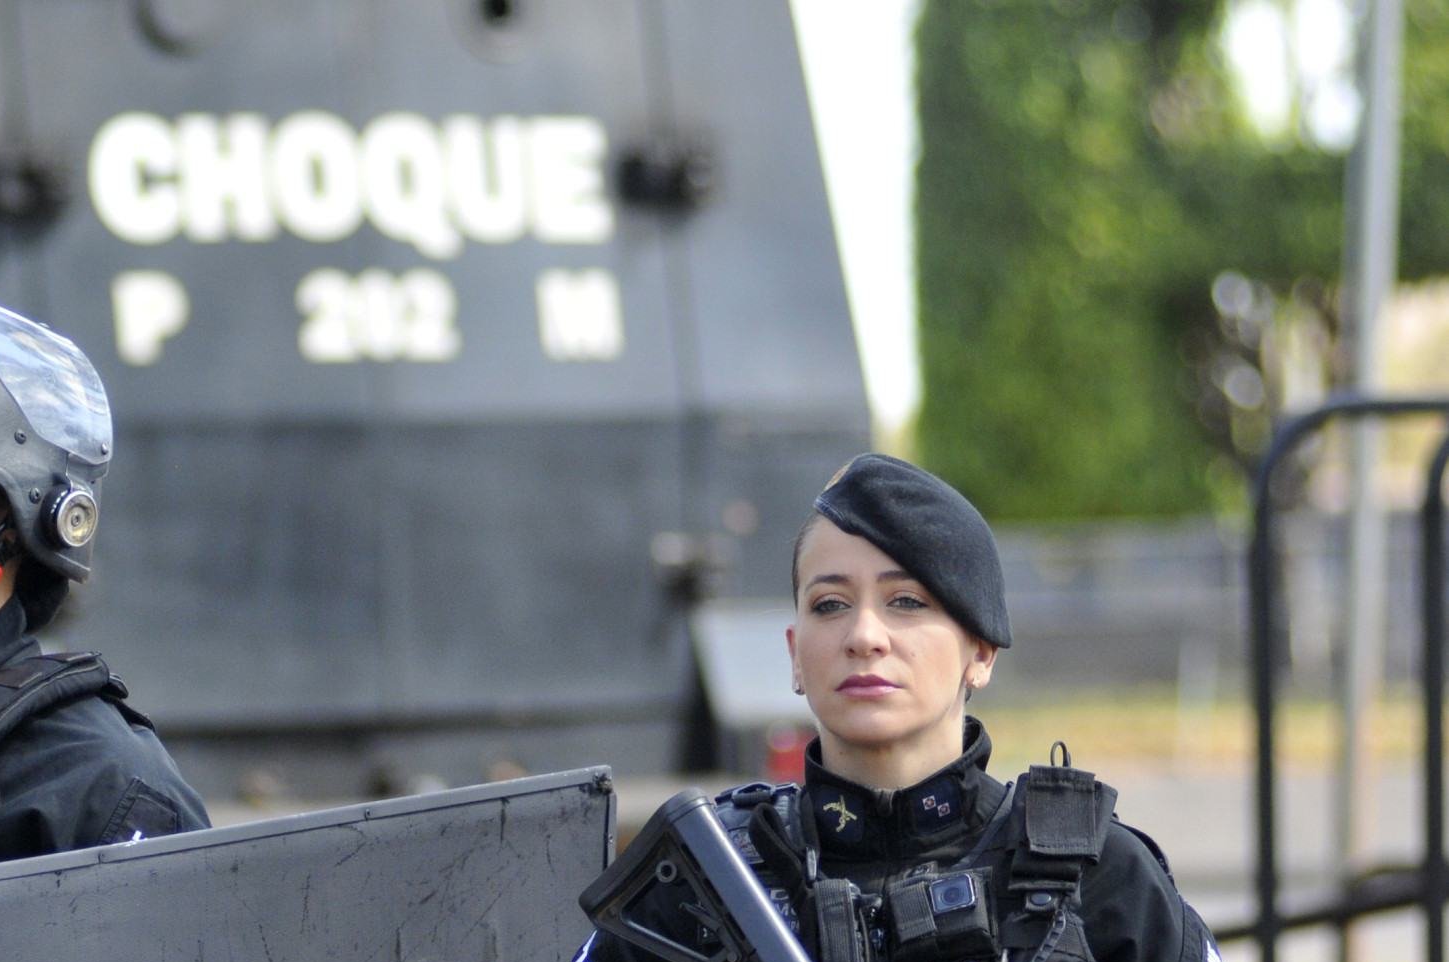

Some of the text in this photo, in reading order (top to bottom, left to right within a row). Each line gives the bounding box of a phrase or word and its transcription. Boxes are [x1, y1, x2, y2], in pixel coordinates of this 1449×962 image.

[88, 108, 614, 260] CHOQUE
[111, 266, 624, 365] P 202 M
